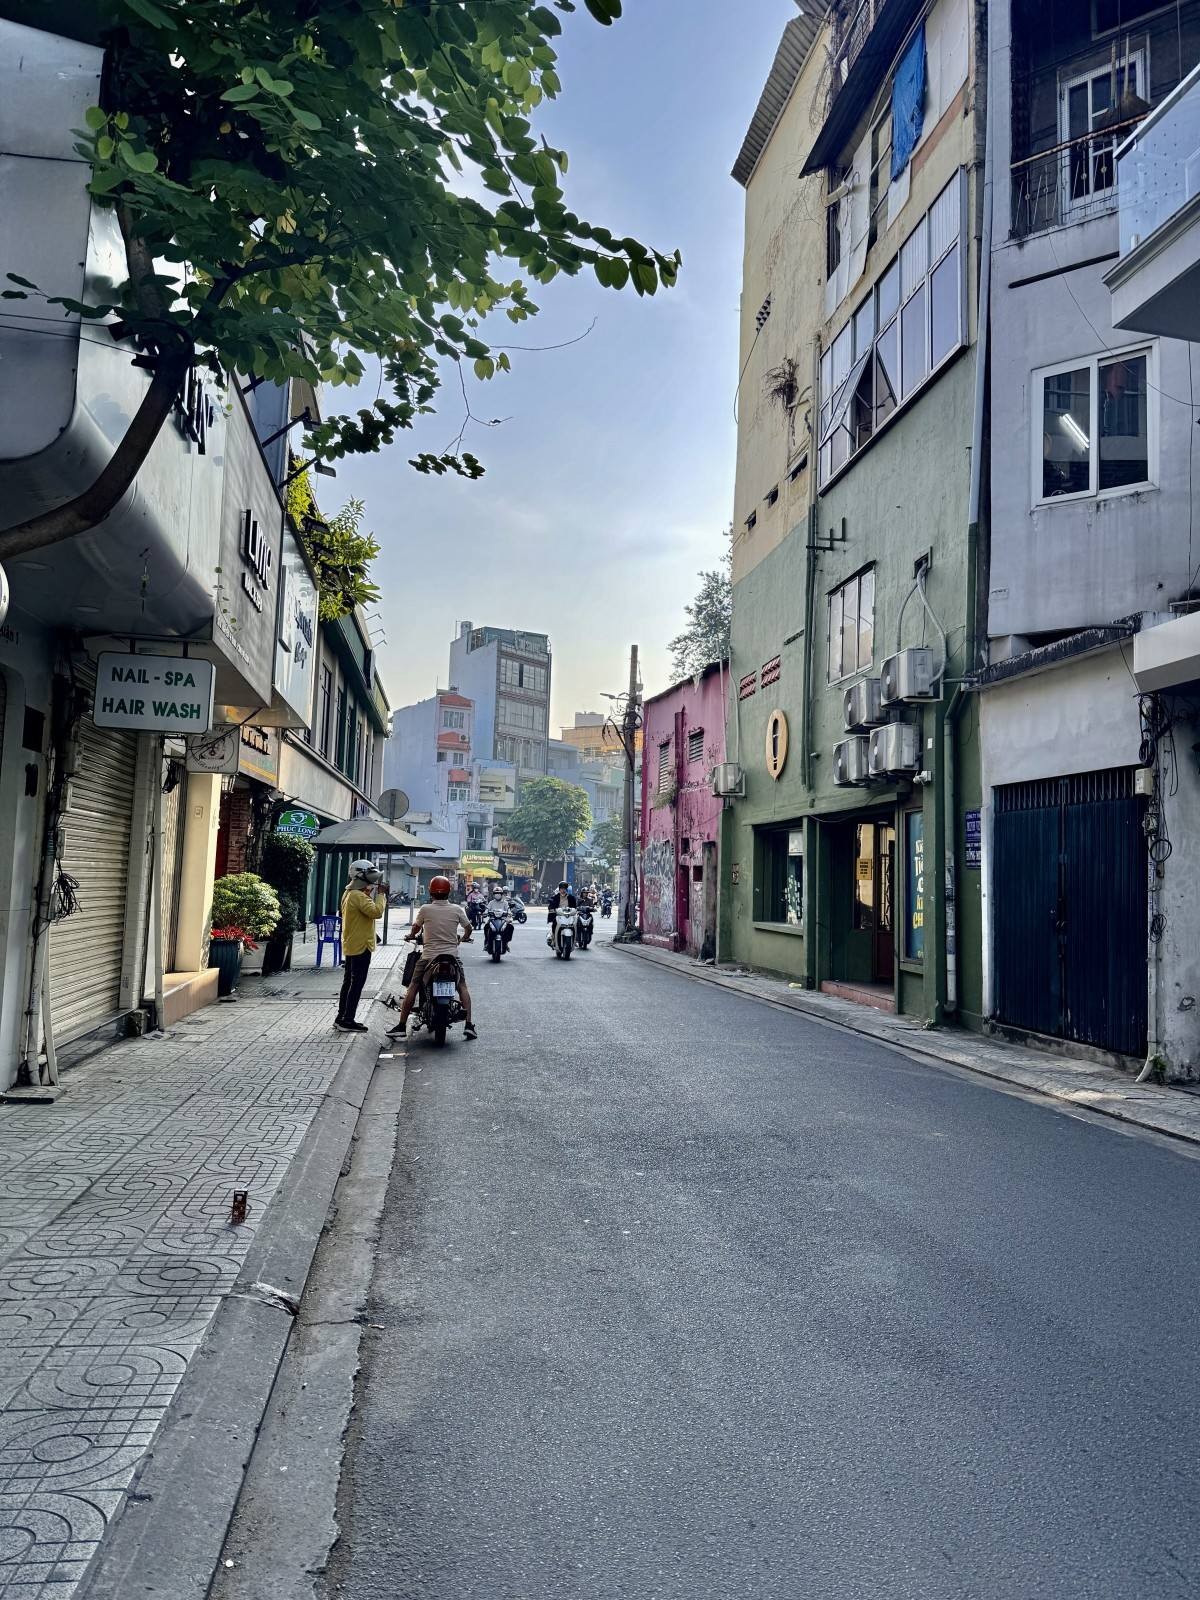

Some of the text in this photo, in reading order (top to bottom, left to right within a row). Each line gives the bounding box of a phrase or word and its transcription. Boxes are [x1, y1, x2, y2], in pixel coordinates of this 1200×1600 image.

[111, 667, 149, 684] NAIL
[164, 671, 196, 688] SPA
[102, 697, 200, 719] HAIR WASH
[297, 827, 317, 836] LONG
